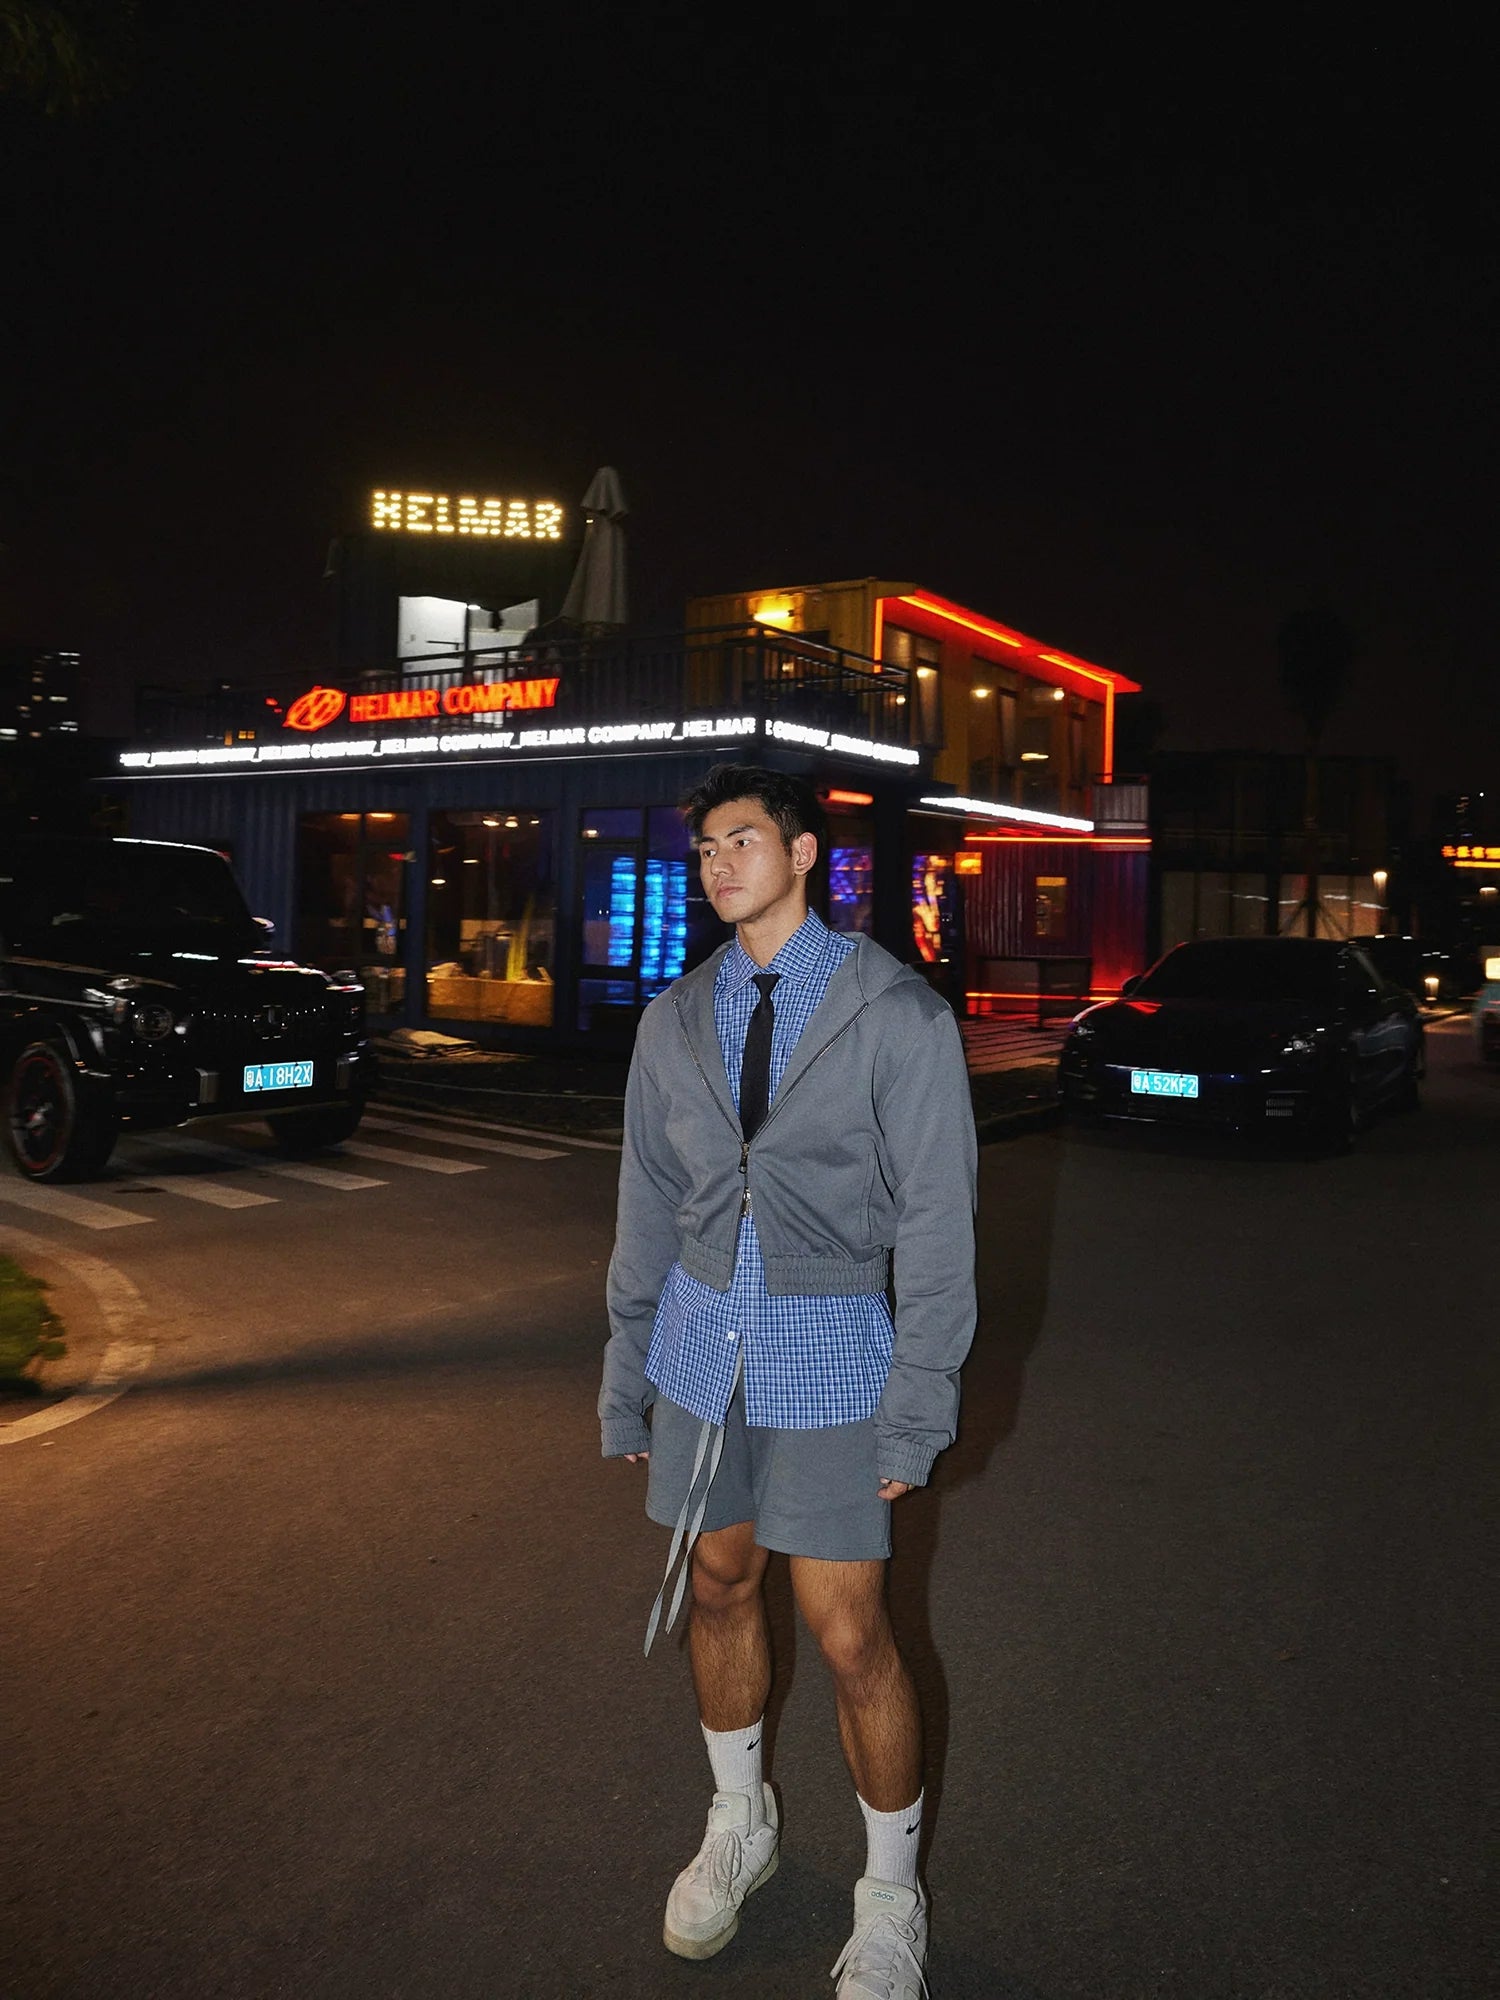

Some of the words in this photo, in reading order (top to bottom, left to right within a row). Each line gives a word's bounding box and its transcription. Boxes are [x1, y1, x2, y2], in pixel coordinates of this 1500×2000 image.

[371, 489, 564, 540] HELMAR
[348, 689, 441, 723] HELMAR
[443, 677, 560, 715] COMPANY
[871, 1891, 895, 1901] adidas
